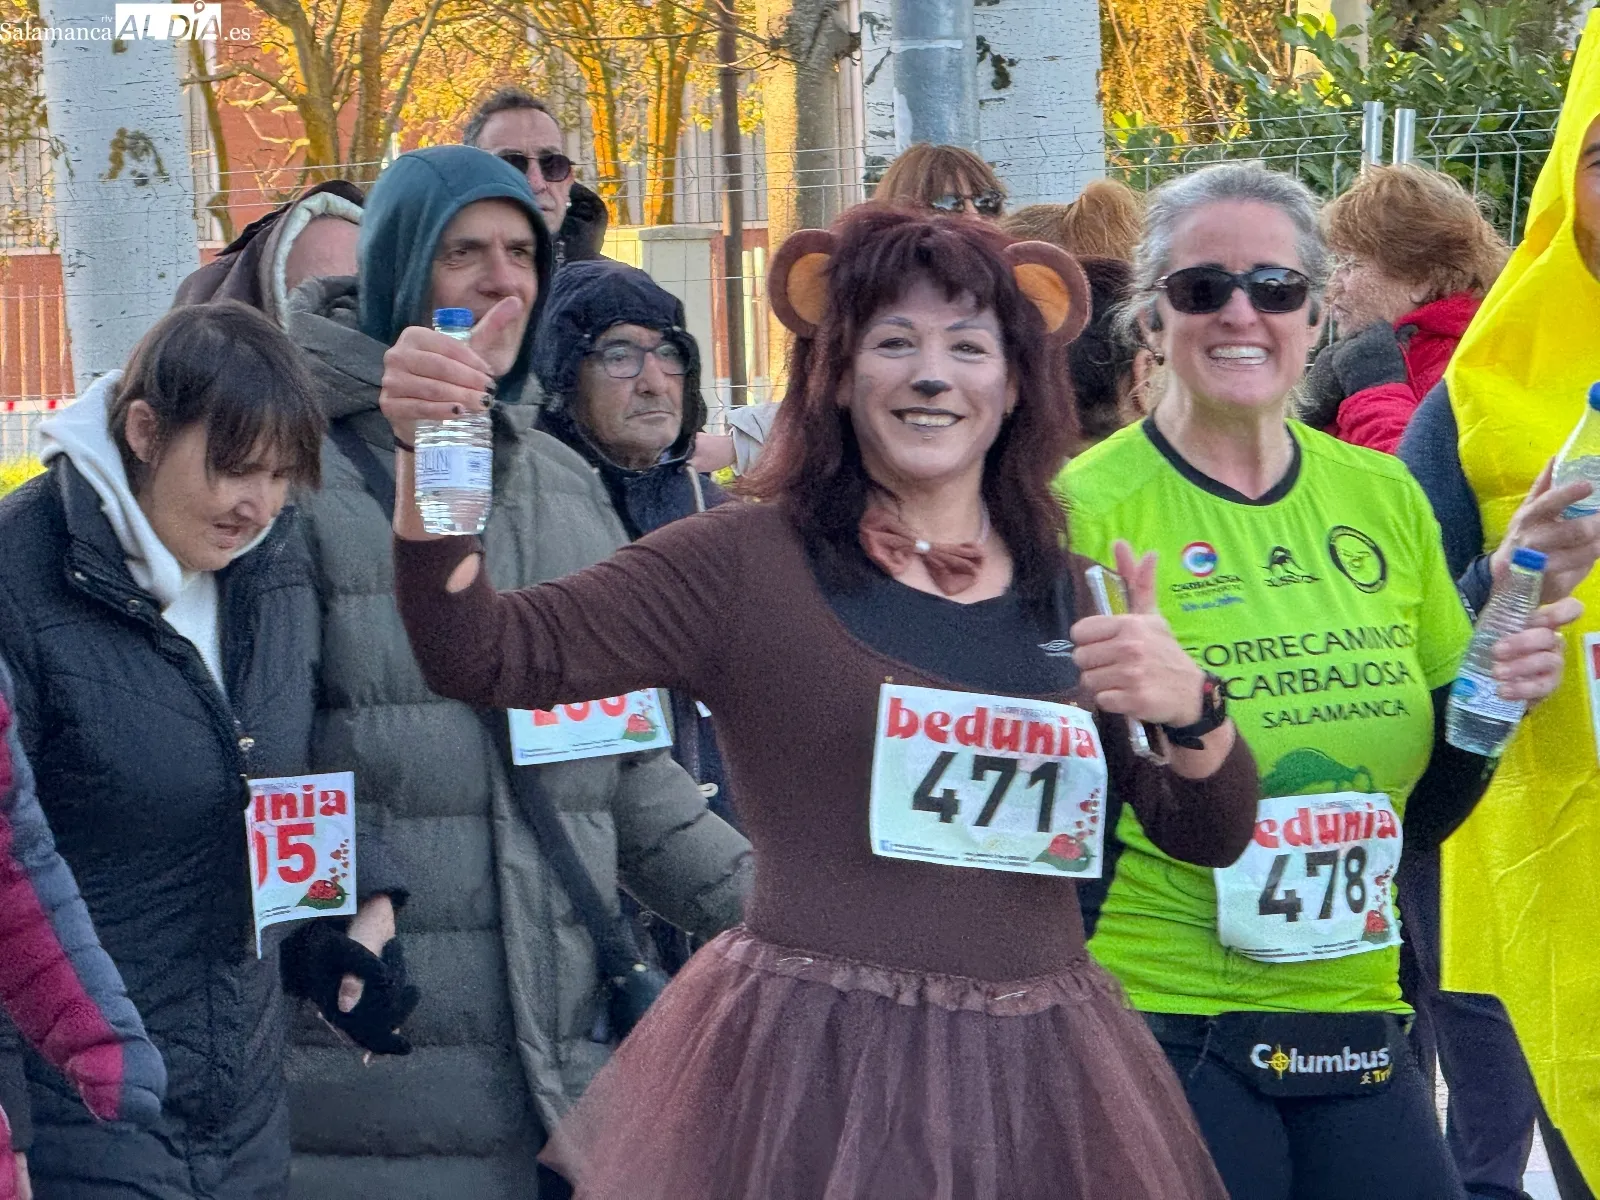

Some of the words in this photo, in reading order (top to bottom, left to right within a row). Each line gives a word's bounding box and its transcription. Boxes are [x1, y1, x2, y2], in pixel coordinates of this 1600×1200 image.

[1223, 661, 1417, 700] CARBAJOSA
[886, 696, 1098, 759] bedunia
[1262, 699, 1411, 729] SALAMANCA
[911, 750, 1061, 833] 471
[1254, 802, 1398, 848] edunia
[1258, 845, 1368, 922] 478
[1250, 1043, 1390, 1079] Columbus
